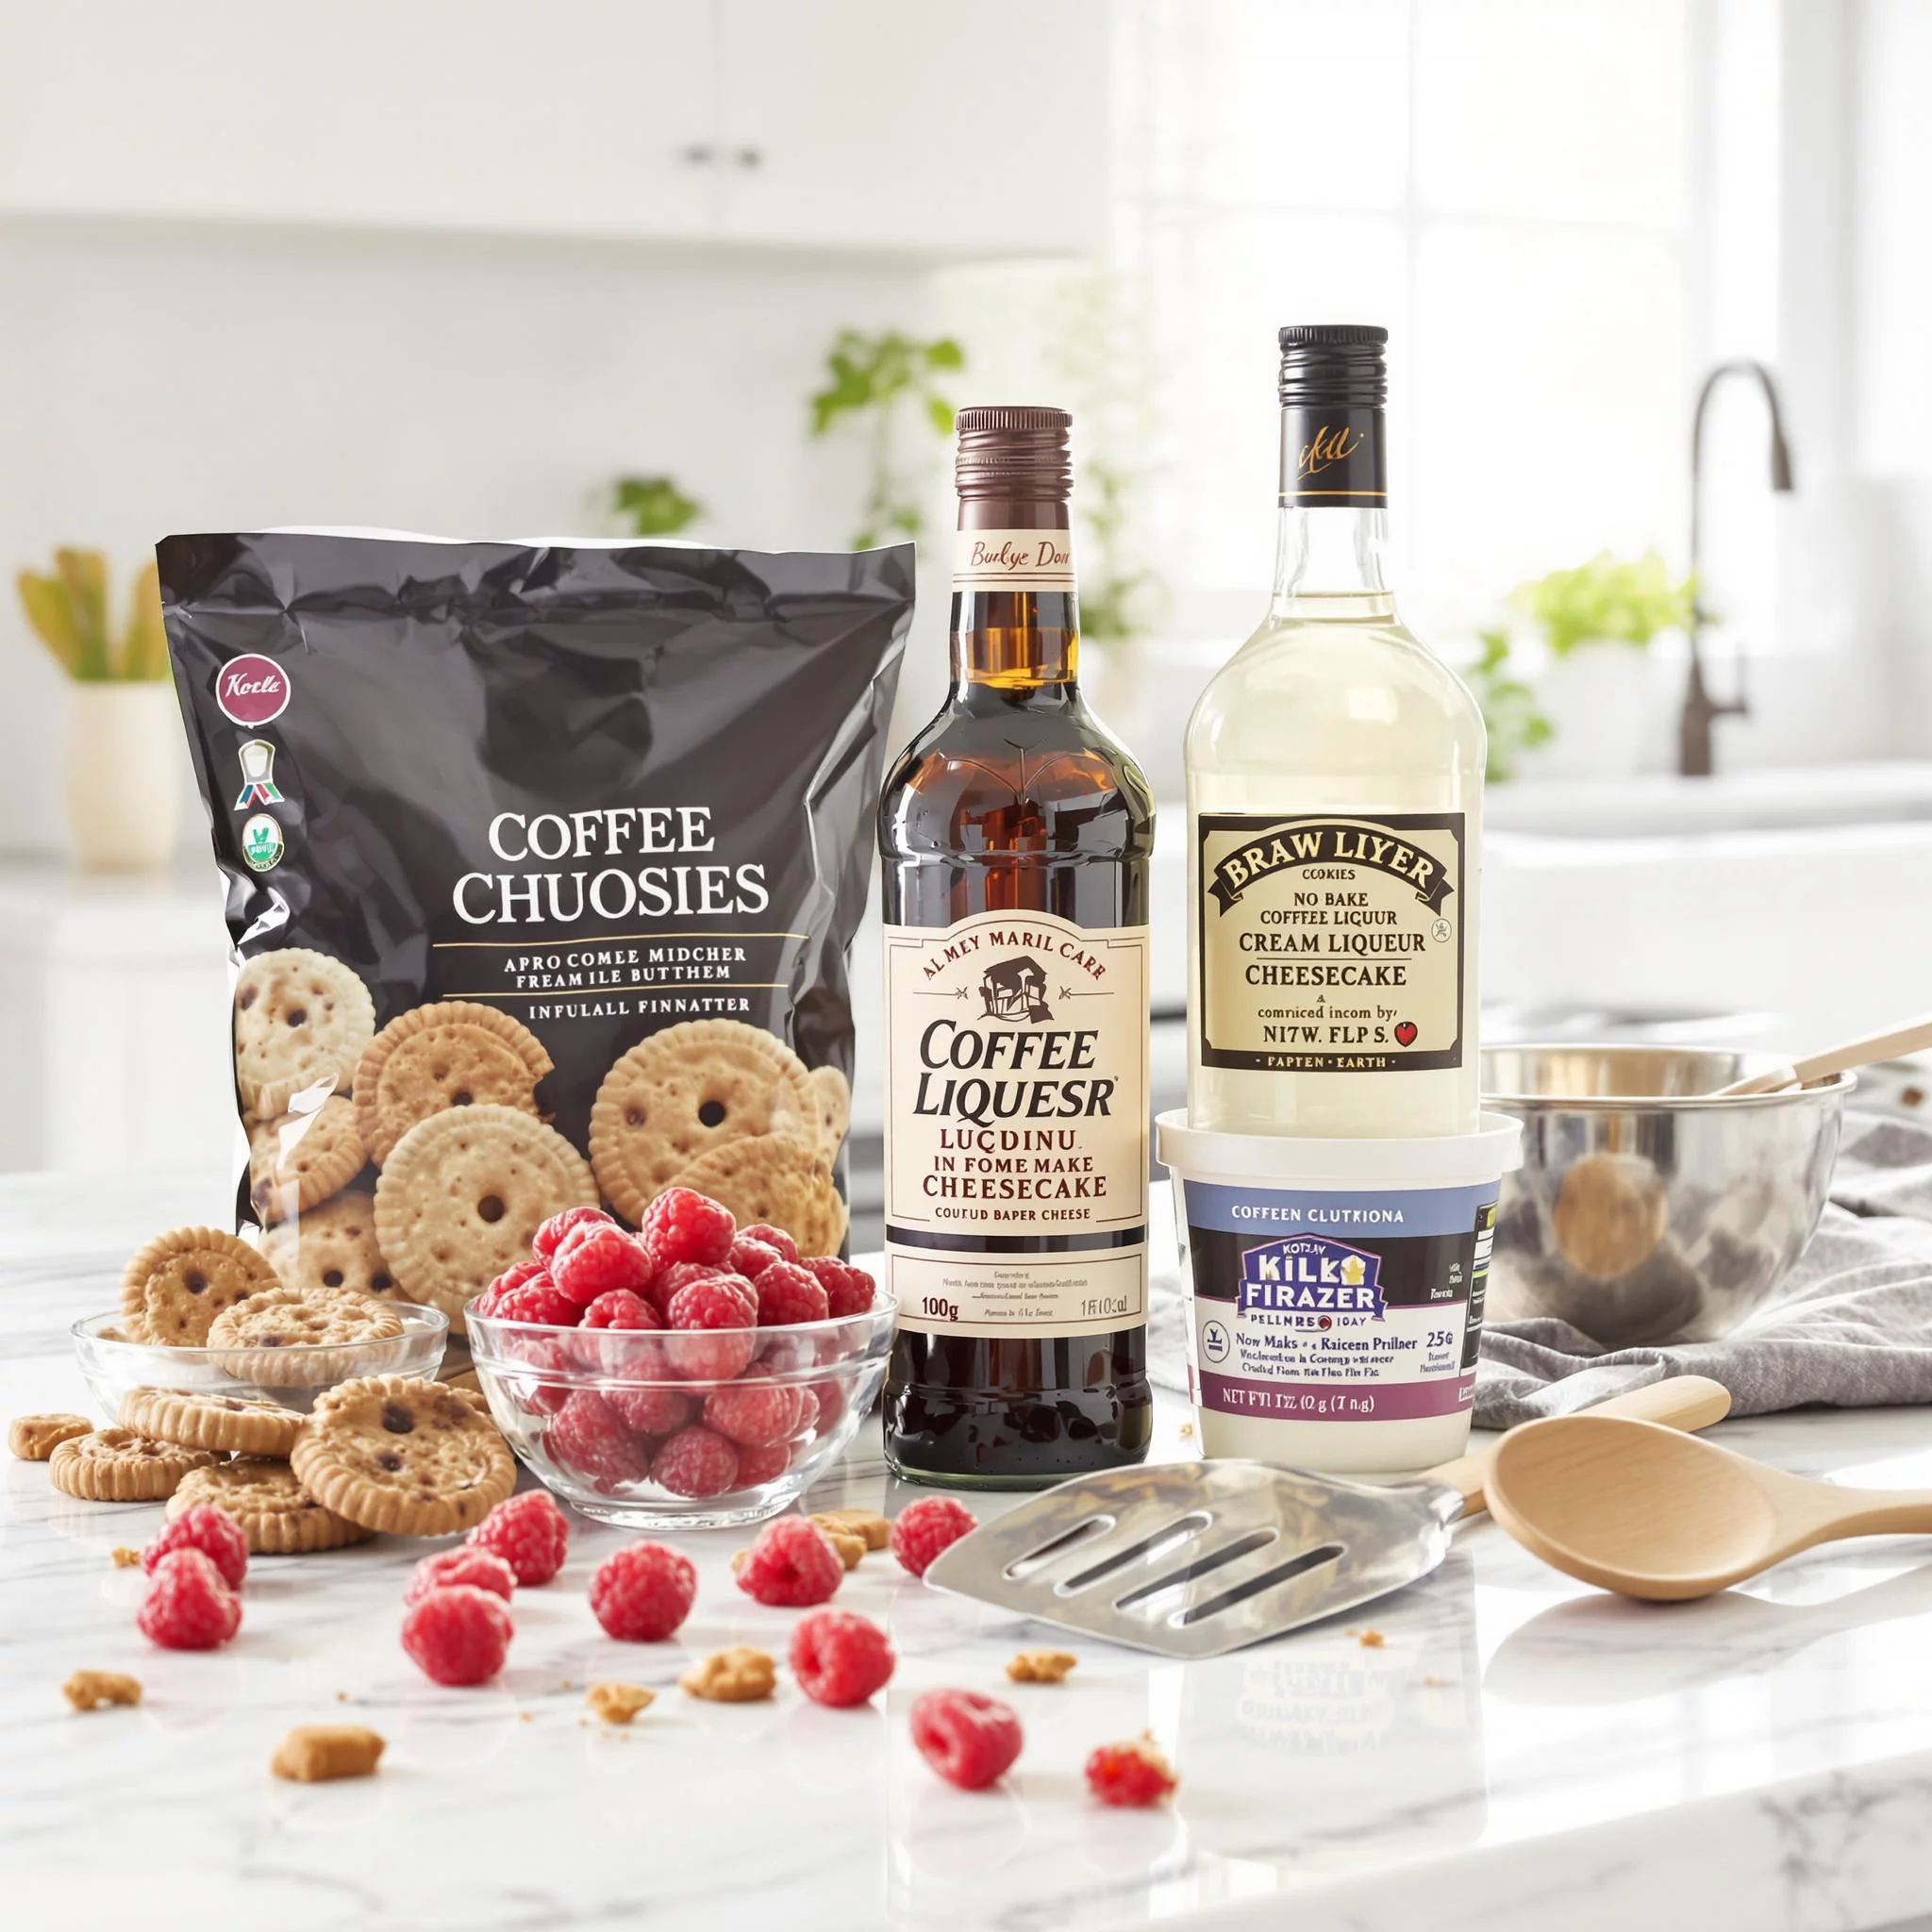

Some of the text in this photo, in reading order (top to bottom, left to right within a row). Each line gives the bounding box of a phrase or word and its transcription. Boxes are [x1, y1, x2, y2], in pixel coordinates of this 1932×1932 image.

[489, 807, 715, 861] COFFEE
[1223, 831, 1434, 889] BRAW LIYER
[453, 864, 769, 924] CHUOSIES
[1294, 892, 1368, 907] NO BAKE
[990, 931, 1054, 953] MARIL
[1239, 933, 1425, 956] CREAM LIQUEUR
[504, 956, 560, 973] APRO
[649, 947, 746, 963] MIDCHER
[517, 973, 582, 988] FREAM
[631, 965, 730, 982] BUTTHEM
[1245, 964, 1407, 986] CHEESECAKE
[529, 998, 750, 1019] INFULALL FINNATTER
[1329, 1006, 1371, 1018] incom
[920, 1019, 1098, 1070] COFFEE
[1336, 1058, 1387, 1068] EARTH
[912, 1072, 1115, 1127] LIQUESR
[934, 1156, 1093, 1174] IN FOME MAKE
[923, 1175, 1107, 1199] CHEESECAKE
[994, 1209, 1036, 1221] BAPER
[1041, 1208, 1091, 1220] CHEESE
[1231, 1205, 1301, 1222] COFFEEN
[1246, 1283, 1374, 1309] FIRAZER
[922, 1297, 958, 1321] 100g
[1223, 1388, 1245, 1405] NET
